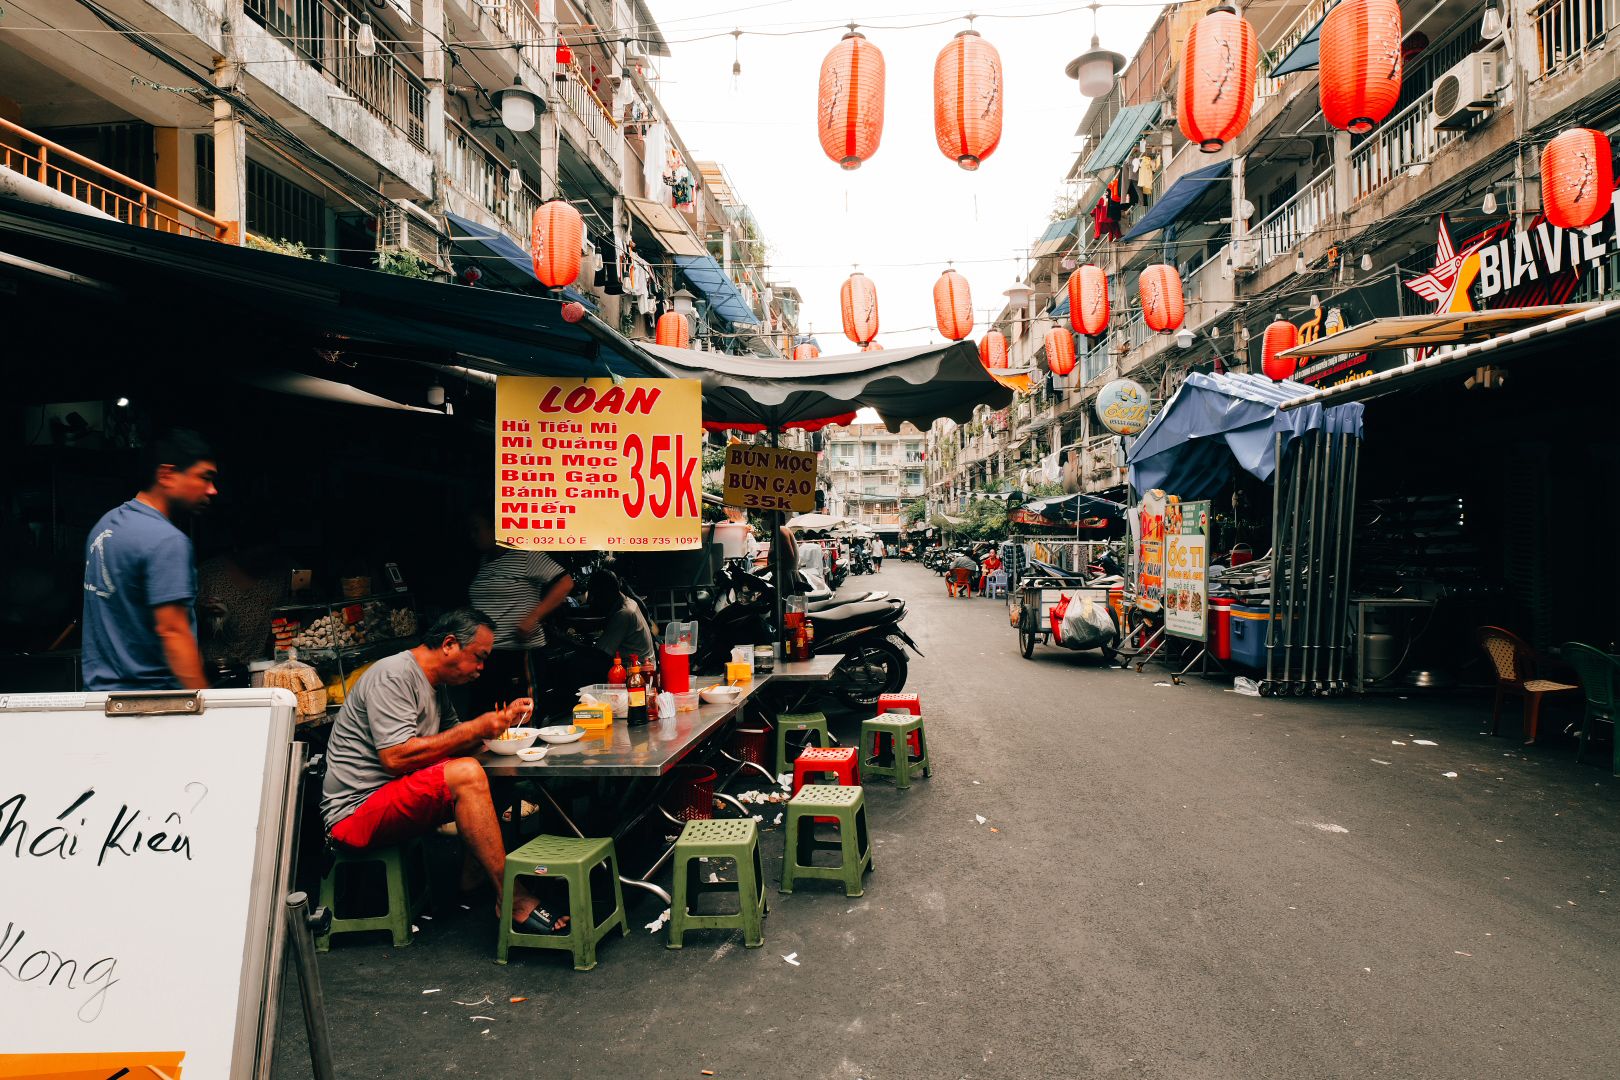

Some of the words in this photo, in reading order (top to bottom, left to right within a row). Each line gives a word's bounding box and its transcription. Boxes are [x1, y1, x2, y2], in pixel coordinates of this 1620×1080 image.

[1478, 230, 1539, 299] BIA
[538, 385, 662, 415] LOAN
[502, 419, 530, 432] Hủ
[537, 419, 583, 433] Tiếu
[541, 437, 617, 450] Quảng
[501, 453, 552, 466] Bún
[561, 454, 618, 469] Mọc
[730, 446, 770, 468] BÚN
[774, 453, 813, 474] MỌC
[501, 469, 555, 482] Bún
[565, 471, 618, 485] Gạo
[728, 470, 768, 491] BÚN
[772, 477, 812, 497] GẠO
[501, 485, 557, 498] Bánh
[565, 486, 620, 499] Canh
[743, 494, 793, 510] 35k
[501, 517, 566, 530] Nui
[533, 537, 555, 545] 032
[580, 537, 587, 545] E
[629, 537, 649, 545] 038
[652, 537, 671, 545] 735
[675, 537, 699, 545] 1097
